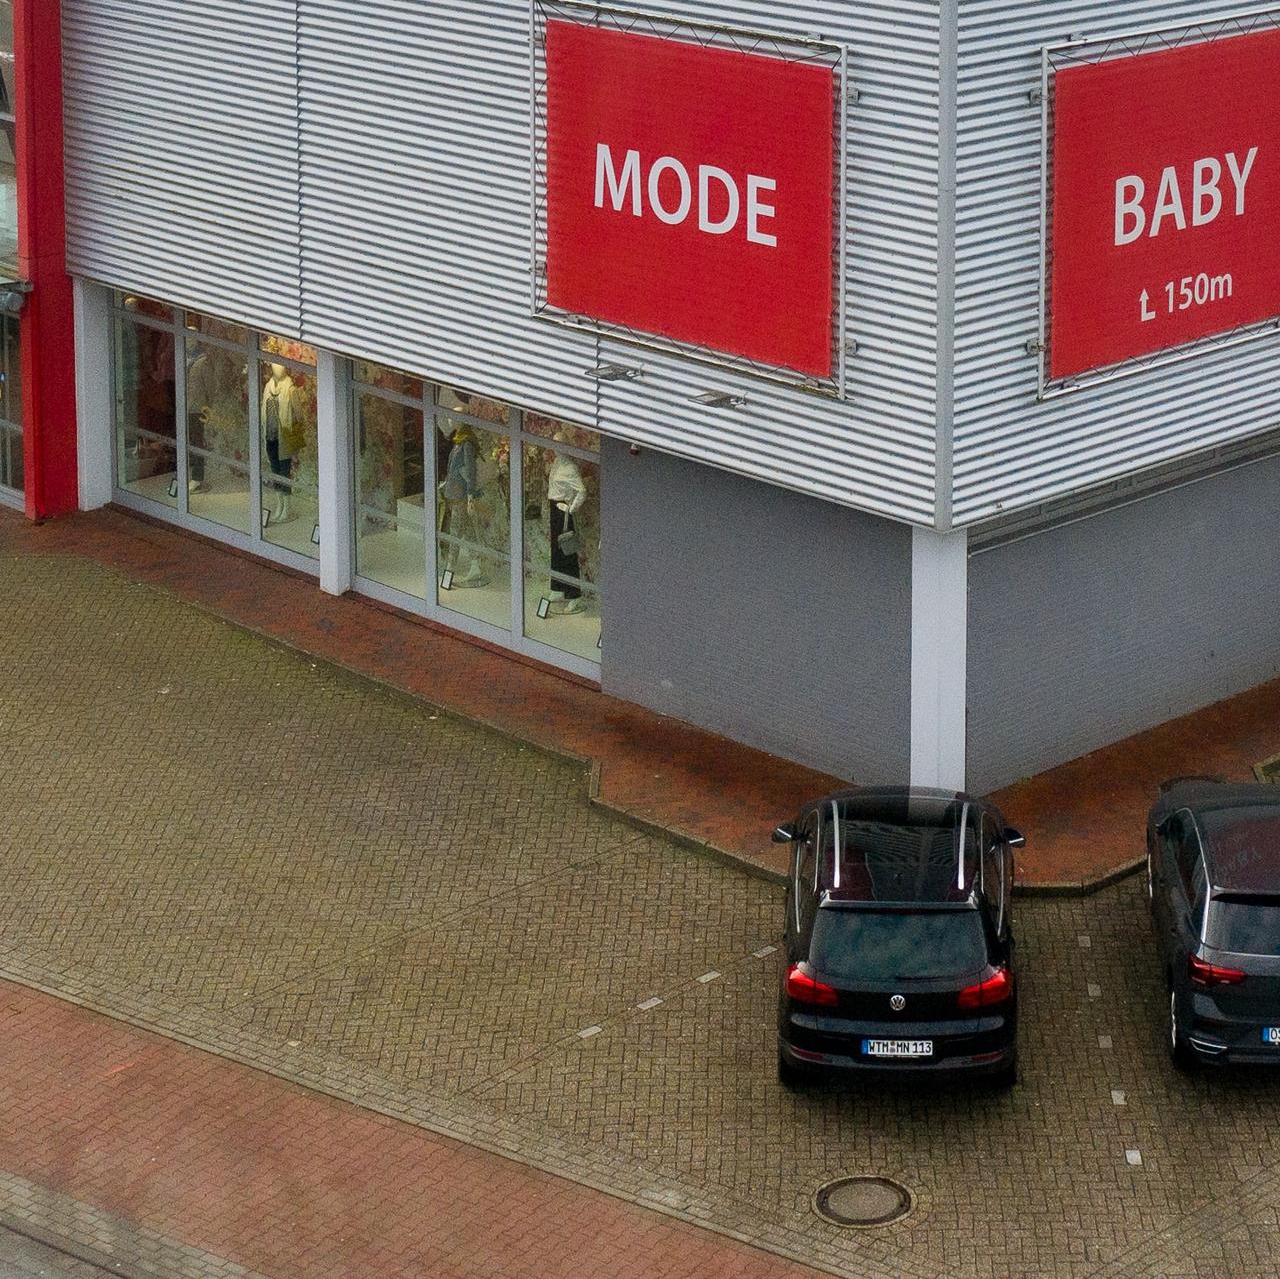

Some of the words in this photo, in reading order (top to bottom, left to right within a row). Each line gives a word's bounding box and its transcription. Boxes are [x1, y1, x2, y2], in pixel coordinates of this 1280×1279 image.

[594, 142, 777, 248] MODE
[1114, 146, 1259, 247] BABY
[1164, 272, 1233, 314] 150m
[868, 1041, 889, 1053] WTM
[896, 1042, 910, 1053] MN
[912, 1042, 932, 1054] 113
